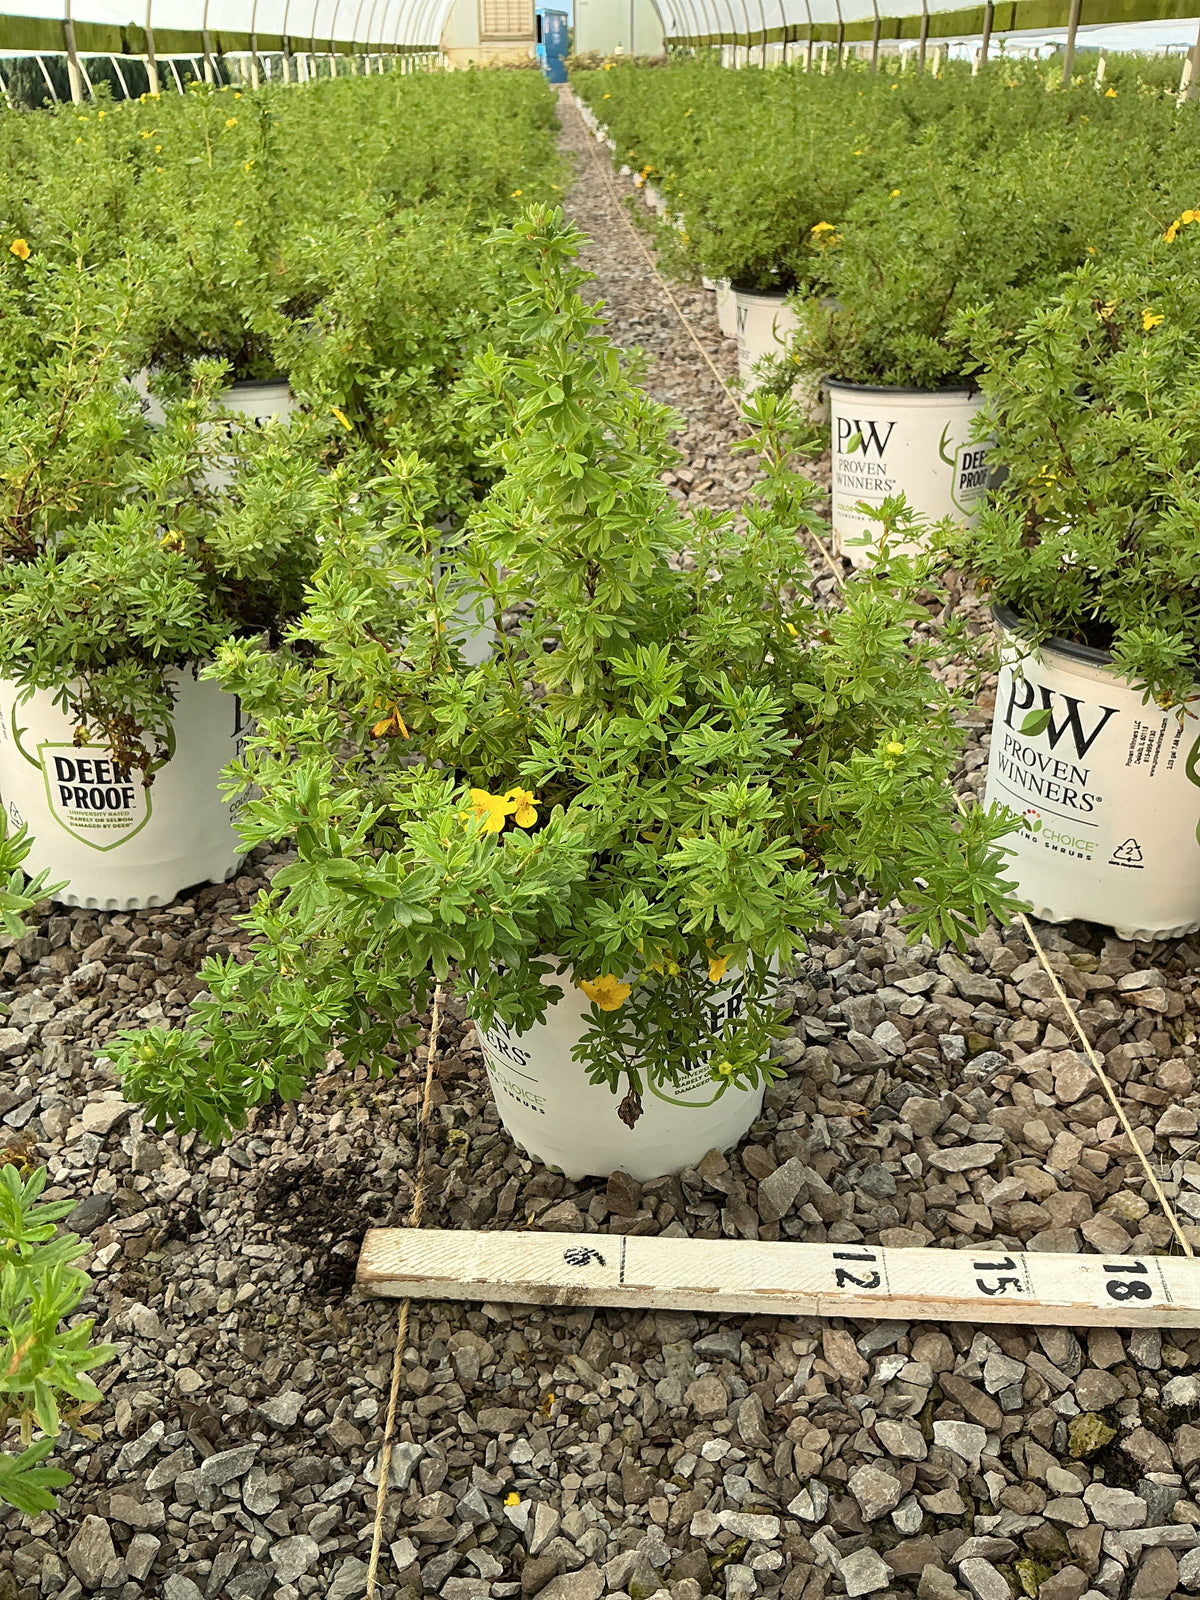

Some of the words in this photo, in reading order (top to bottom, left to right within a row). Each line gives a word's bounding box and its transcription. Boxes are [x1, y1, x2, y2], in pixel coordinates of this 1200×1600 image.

[836, 417, 897, 458] PW
[838, 458, 887, 476] PROVEN
[962, 450, 988, 471] DEE
[1003, 667, 1120, 760] PW
[1004, 733, 1090, 788] PROVEN
[69, 809, 107, 817] UNIVERSITY
[1044, 842, 1092, 861] SHRUBS
[1125, 846, 1134, 855] 2
[832, 1249, 881, 1289] 12
[973, 1256, 1023, 1296] 15
[1103, 1261, 1152, 1301] 18
